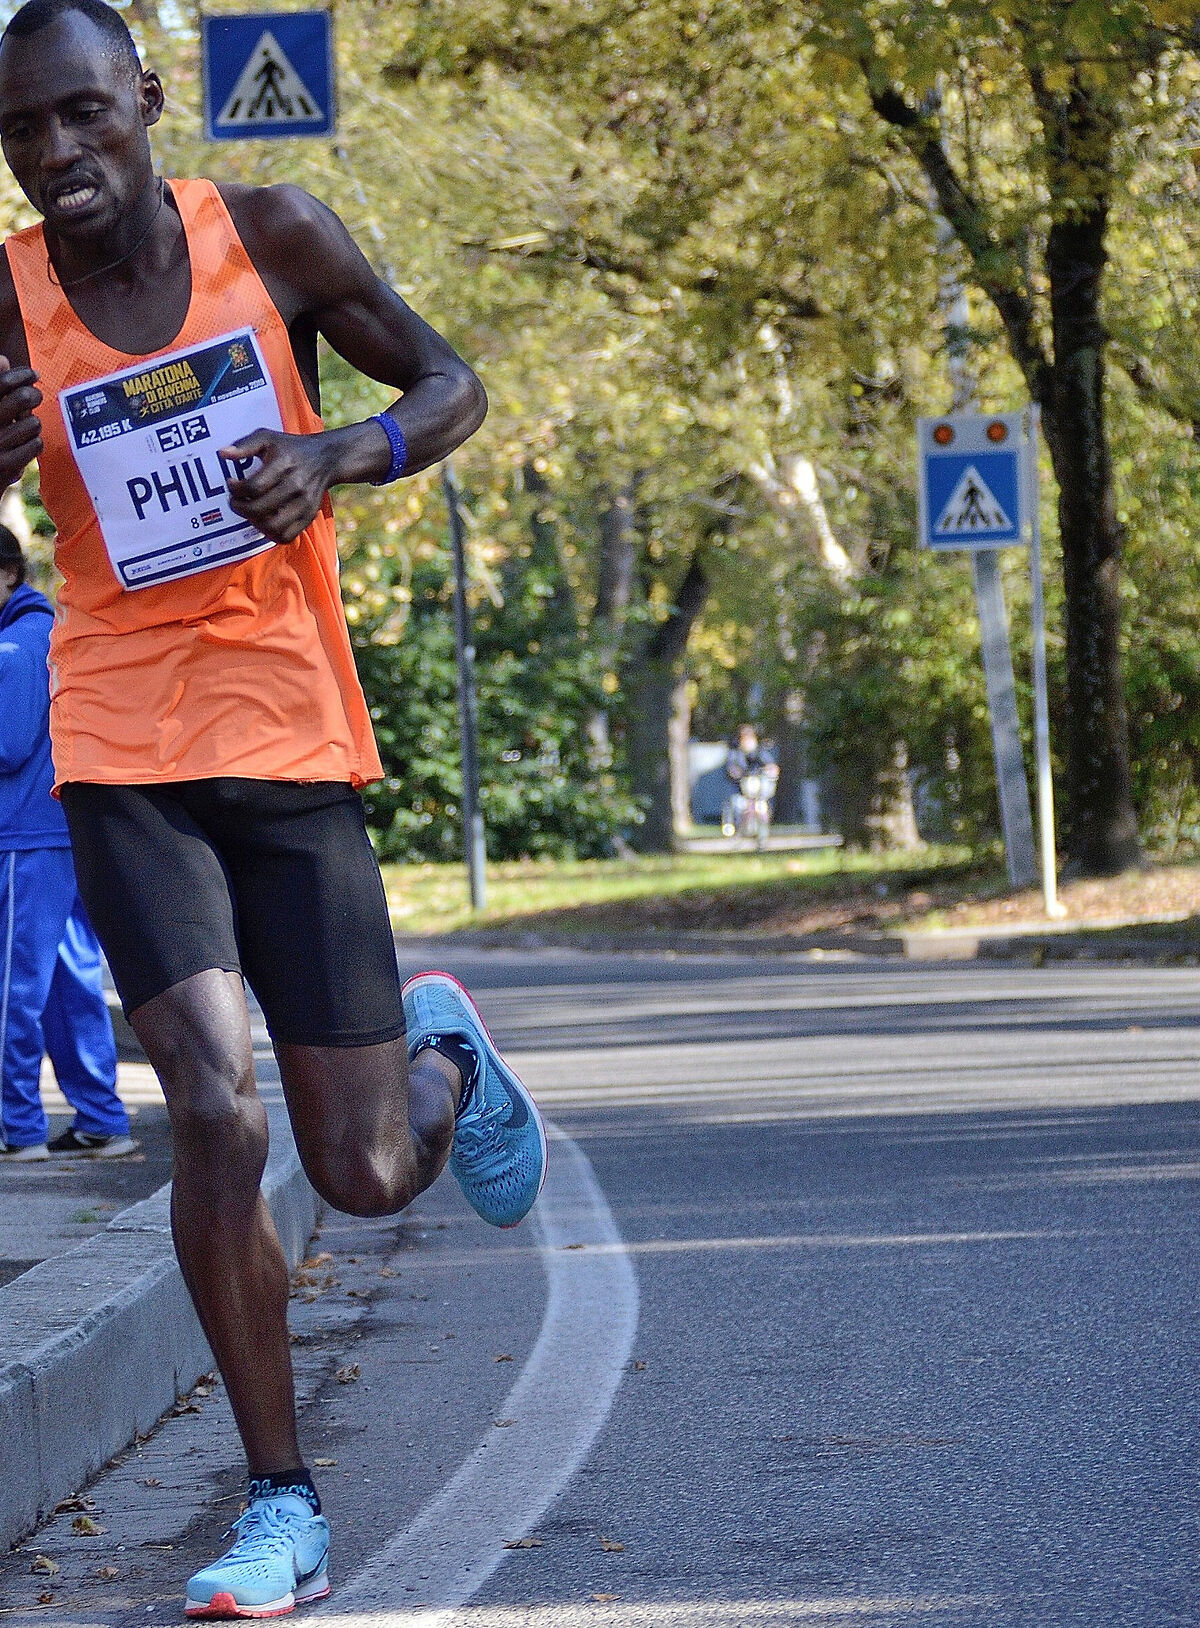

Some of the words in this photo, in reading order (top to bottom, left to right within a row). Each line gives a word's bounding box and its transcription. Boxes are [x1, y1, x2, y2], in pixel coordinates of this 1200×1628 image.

[122, 360, 194, 397] MARATONA
[145, 391, 158, 404] DI
[157, 376, 201, 398] RAVENNA
[81, 421, 122, 445] 42,195
[121, 419, 133, 431] K
[190, 517, 200, 529] 8
